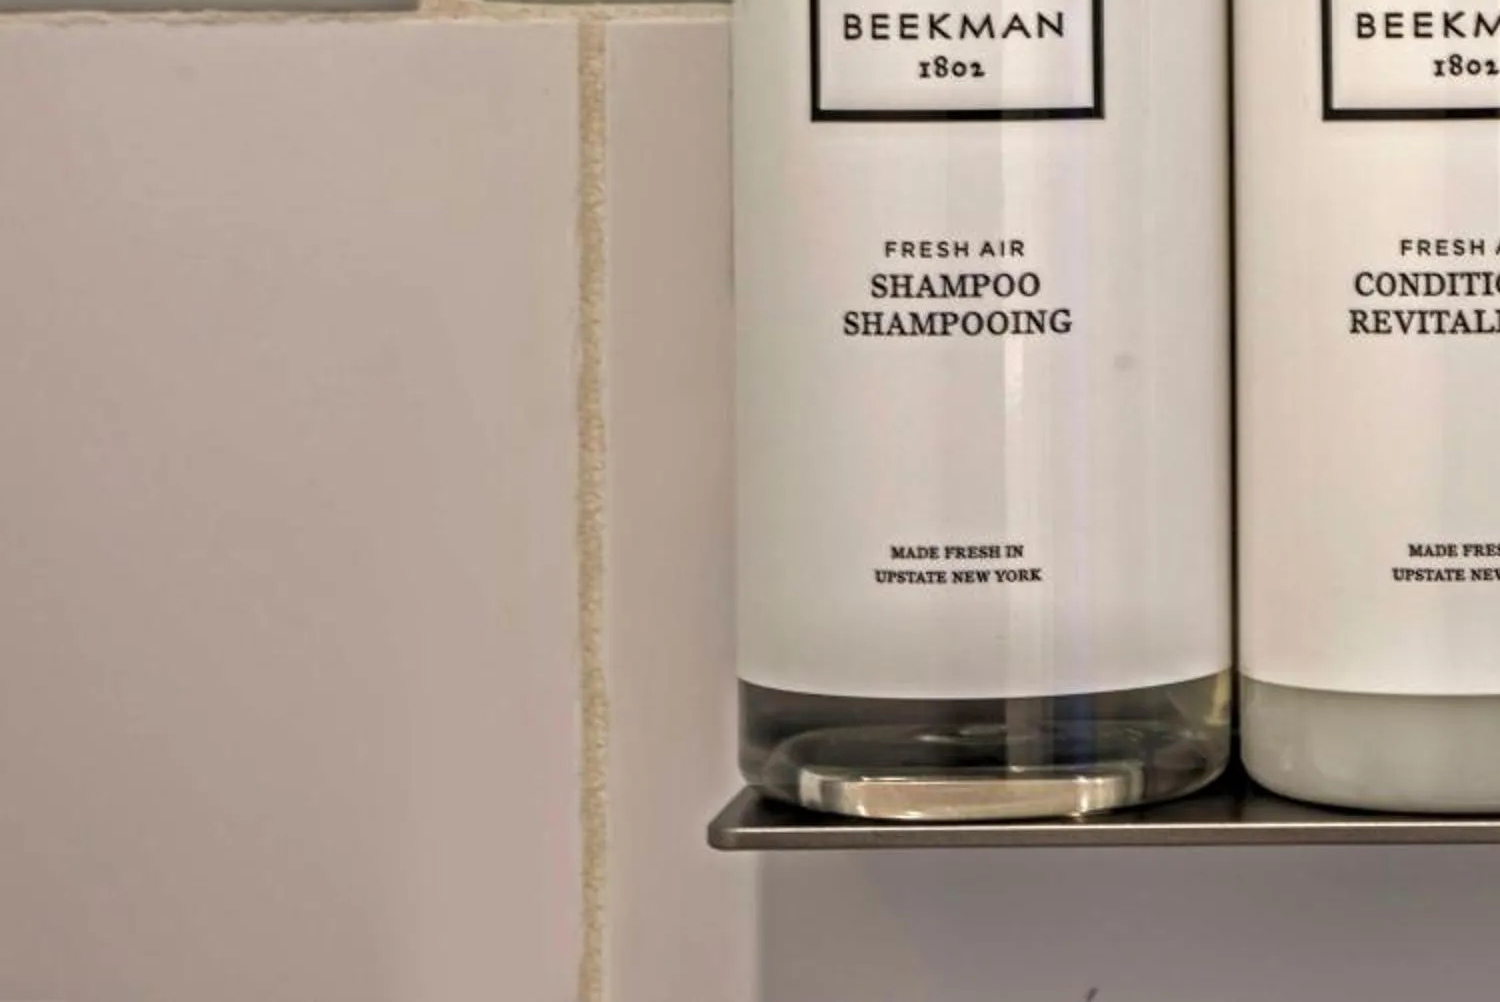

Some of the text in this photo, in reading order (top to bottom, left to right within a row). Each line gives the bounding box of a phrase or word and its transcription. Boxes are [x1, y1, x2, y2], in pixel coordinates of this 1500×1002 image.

[842, 10, 1065, 42] BEEKMAN
[918, 54, 987, 79] 1802
[1432, 53, 1500, 78] 1802
[884, 238, 1025, 259] FRESH AIR
[1399, 237, 1486, 257] FRESH
[870, 271, 1041, 299] SHAMPOO
[842, 307, 1073, 337] SHAMPOOING
[890, 544, 1025, 561] MADE FRESH IN
[1407, 542, 1459, 558] MADE
[874, 567, 1043, 585] UPSTATE NEW YORK
[1391, 565, 1467, 583] UPSTATE
